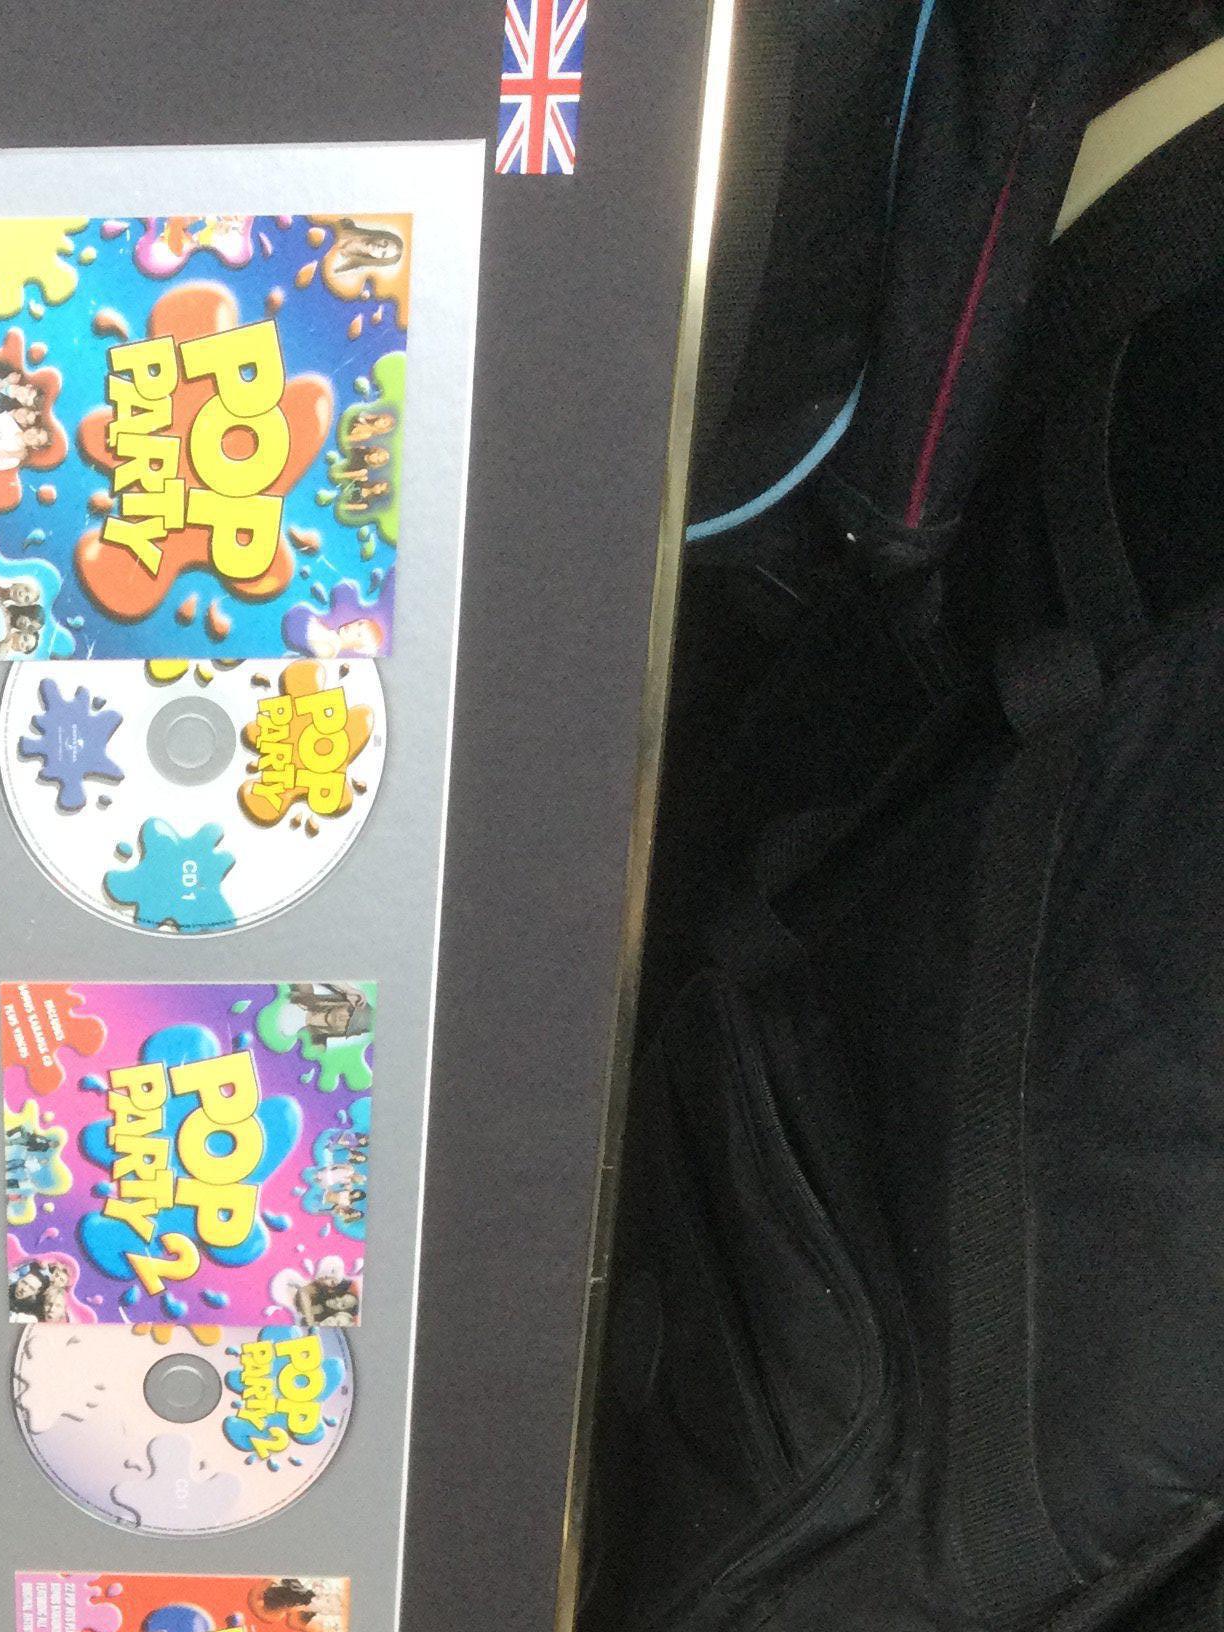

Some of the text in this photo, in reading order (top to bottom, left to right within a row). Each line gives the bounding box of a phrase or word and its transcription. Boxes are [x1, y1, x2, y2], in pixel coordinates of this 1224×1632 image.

[103, 335, 184, 577] PARTY
[180, 319, 290, 579] POP
[253, 694, 295, 813] PARTY
[295, 687, 349, 814] POP
[182, 860, 197, 887] CD
[103, 1062, 200, 1296] PARTY 2
[169, 1051, 264, 1247] POP
[238, 1340, 289, 1460] PARTY 2
[275, 1336, 325, 1434] POP
